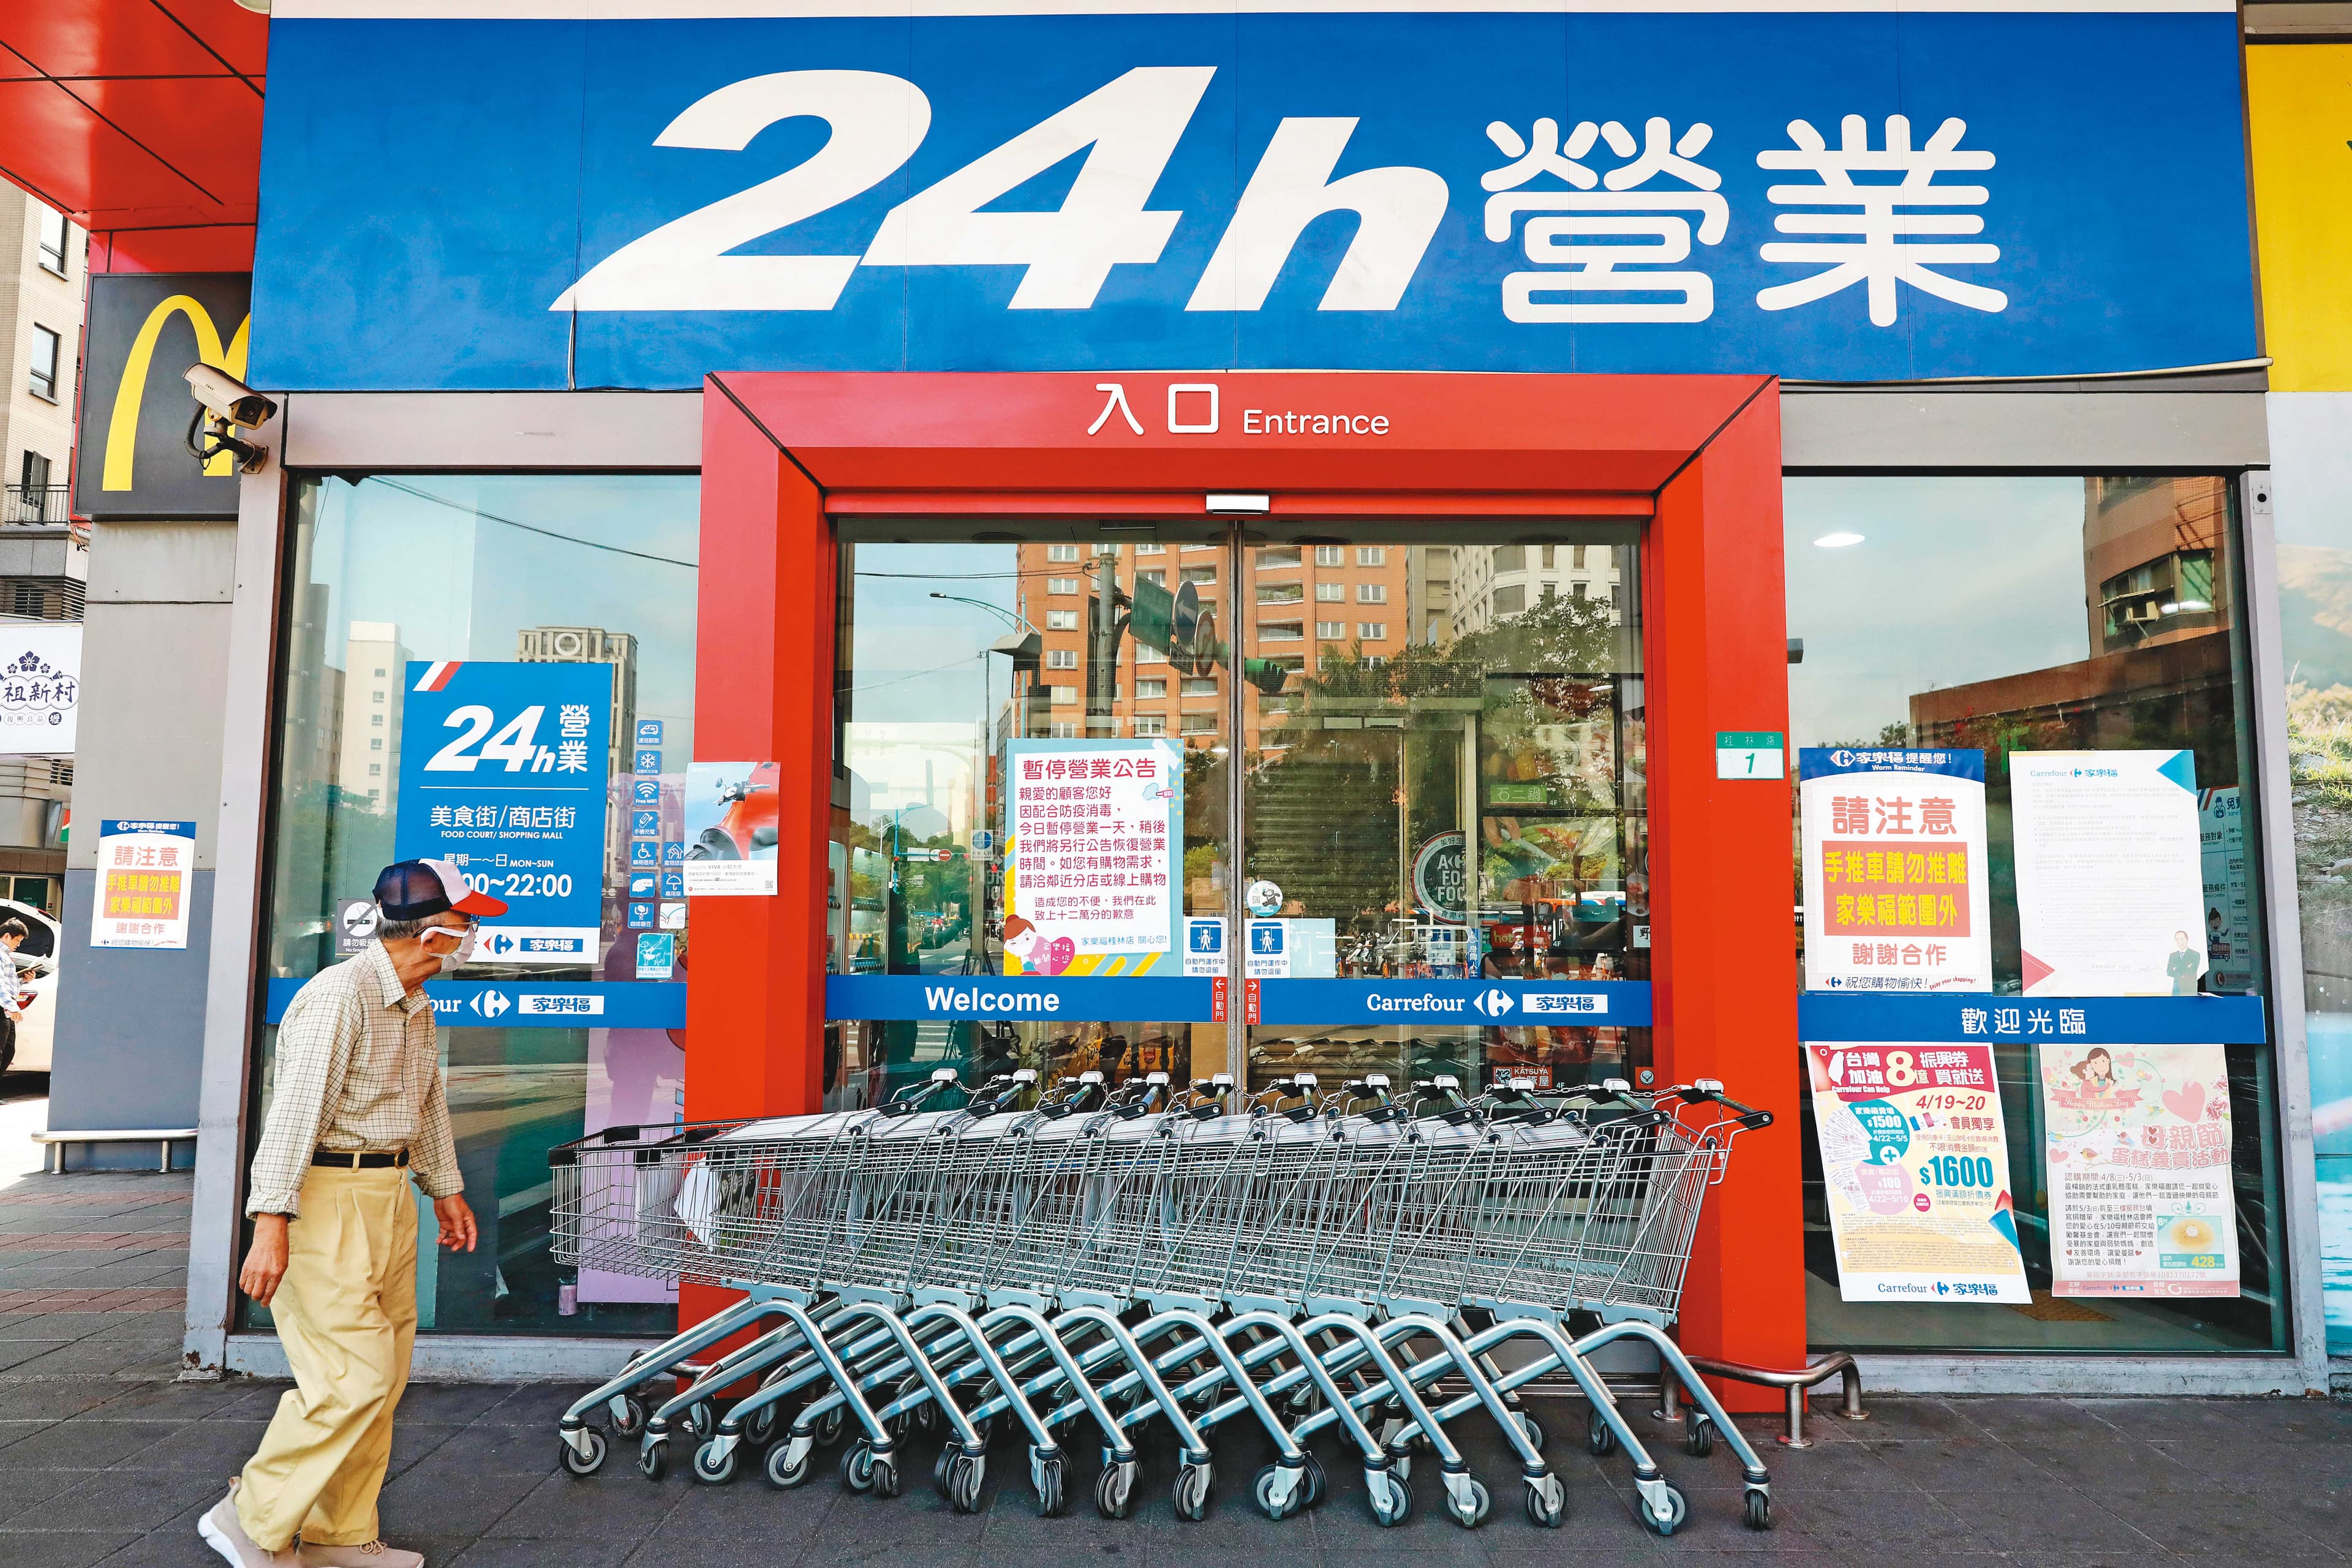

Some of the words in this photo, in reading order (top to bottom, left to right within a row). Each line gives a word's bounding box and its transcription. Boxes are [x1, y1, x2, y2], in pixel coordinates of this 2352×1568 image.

[1087, 383, 1219, 435] 入口
[1243, 409, 1389, 434] Entrance
[2, 681, 75, 703] 祖新村
[423, 705, 556, 772] 24h
[557, 704, 590, 774] 營業
[1725, 735, 1774, 746] 桂林路
[1023, 758, 1156, 780] 暫停營業公告
[1745, 753, 1755, 774] 1
[2084, 769, 2117, 777] 家樂福
[1019, 786, 1112, 801] 親愛的顧客您好
[1497, 788, 1541, 801] 石二鍋
[430, 805, 576, 829] 美食街/商店街
[1831, 796, 1957, 835] 請注意
[467, 831, 497, 839] COURT/
[1019, 820, 1166, 835] 今日暫停營業一天，稍後
[1020, 838, 1166, 853] 我們將另行公告恢復營業
[115, 845, 179, 867] 請注意
[1825, 851, 1967, 884] 手推車請勿推離
[107, 874, 181, 893] 手推車請勿推離
[1020, 873, 1166, 888] 請洽鄰近分店或線上購物
[110, 897, 173, 914] 家樂福範圍外
[1035, 895, 1156, 907] 造成您的不便，我們在此
[1035, 910, 1134, 921] 致上十二萬分的歉意
[1836, 892, 1958, 927] 家樂福範圍外
[116, 922, 165, 935] 謝謝合作
[530, 938, 575, 951] 家樂福
[1081, 937, 1134, 946] 家樂福桂林店
[1852, 943, 1947, 966] 謝謝合作
[1929, 981, 1940, 990] Enjoy
[1953, 976, 1976, 984] shopping!
[533, 997, 590, 1012] 家樂福
[925, 987, 1060, 1011] Welcome
[1215, 991, 1224, 1020] 自動門
[1366, 993, 1465, 1012] Carrefour
[1536, 997, 1594, 1011] 家樂福
[1248, 993, 1257, 1022] 自動門
[1961, 1008, 2086, 1035] 歡迎光臨
[1845, 1052, 1881, 1067] 台灣
[1920, 1052, 1969, 1068] 振興券
[1848, 1069, 1883, 1084] 加油
[1934, 1069, 1985, 1085] 買就送
[1916, 1095, 1986, 1110] 4/19~20
[2064, 1098, 2086, 1109] Happy
[2114, 1098, 2128, 1107] Day
[1868, 1115, 1902, 1128] $1500
[1950, 1116, 1995, 1131] 會員獨享
[2141, 1123, 2225, 1151] 母親節
[2112, 1148, 2231, 1170] 蛋糕義賣活動
[1919, 1155, 1994, 1188] $1600
[1878, 1177, 1901, 1189] $100
[1936, 1189, 1992, 1200] 振興滿額折價券
[2192, 1256, 2215, 1267] 428
[1878, 1283, 1928, 1293] Carrefour
[1953, 1283, 1998, 1295] 家樂福
